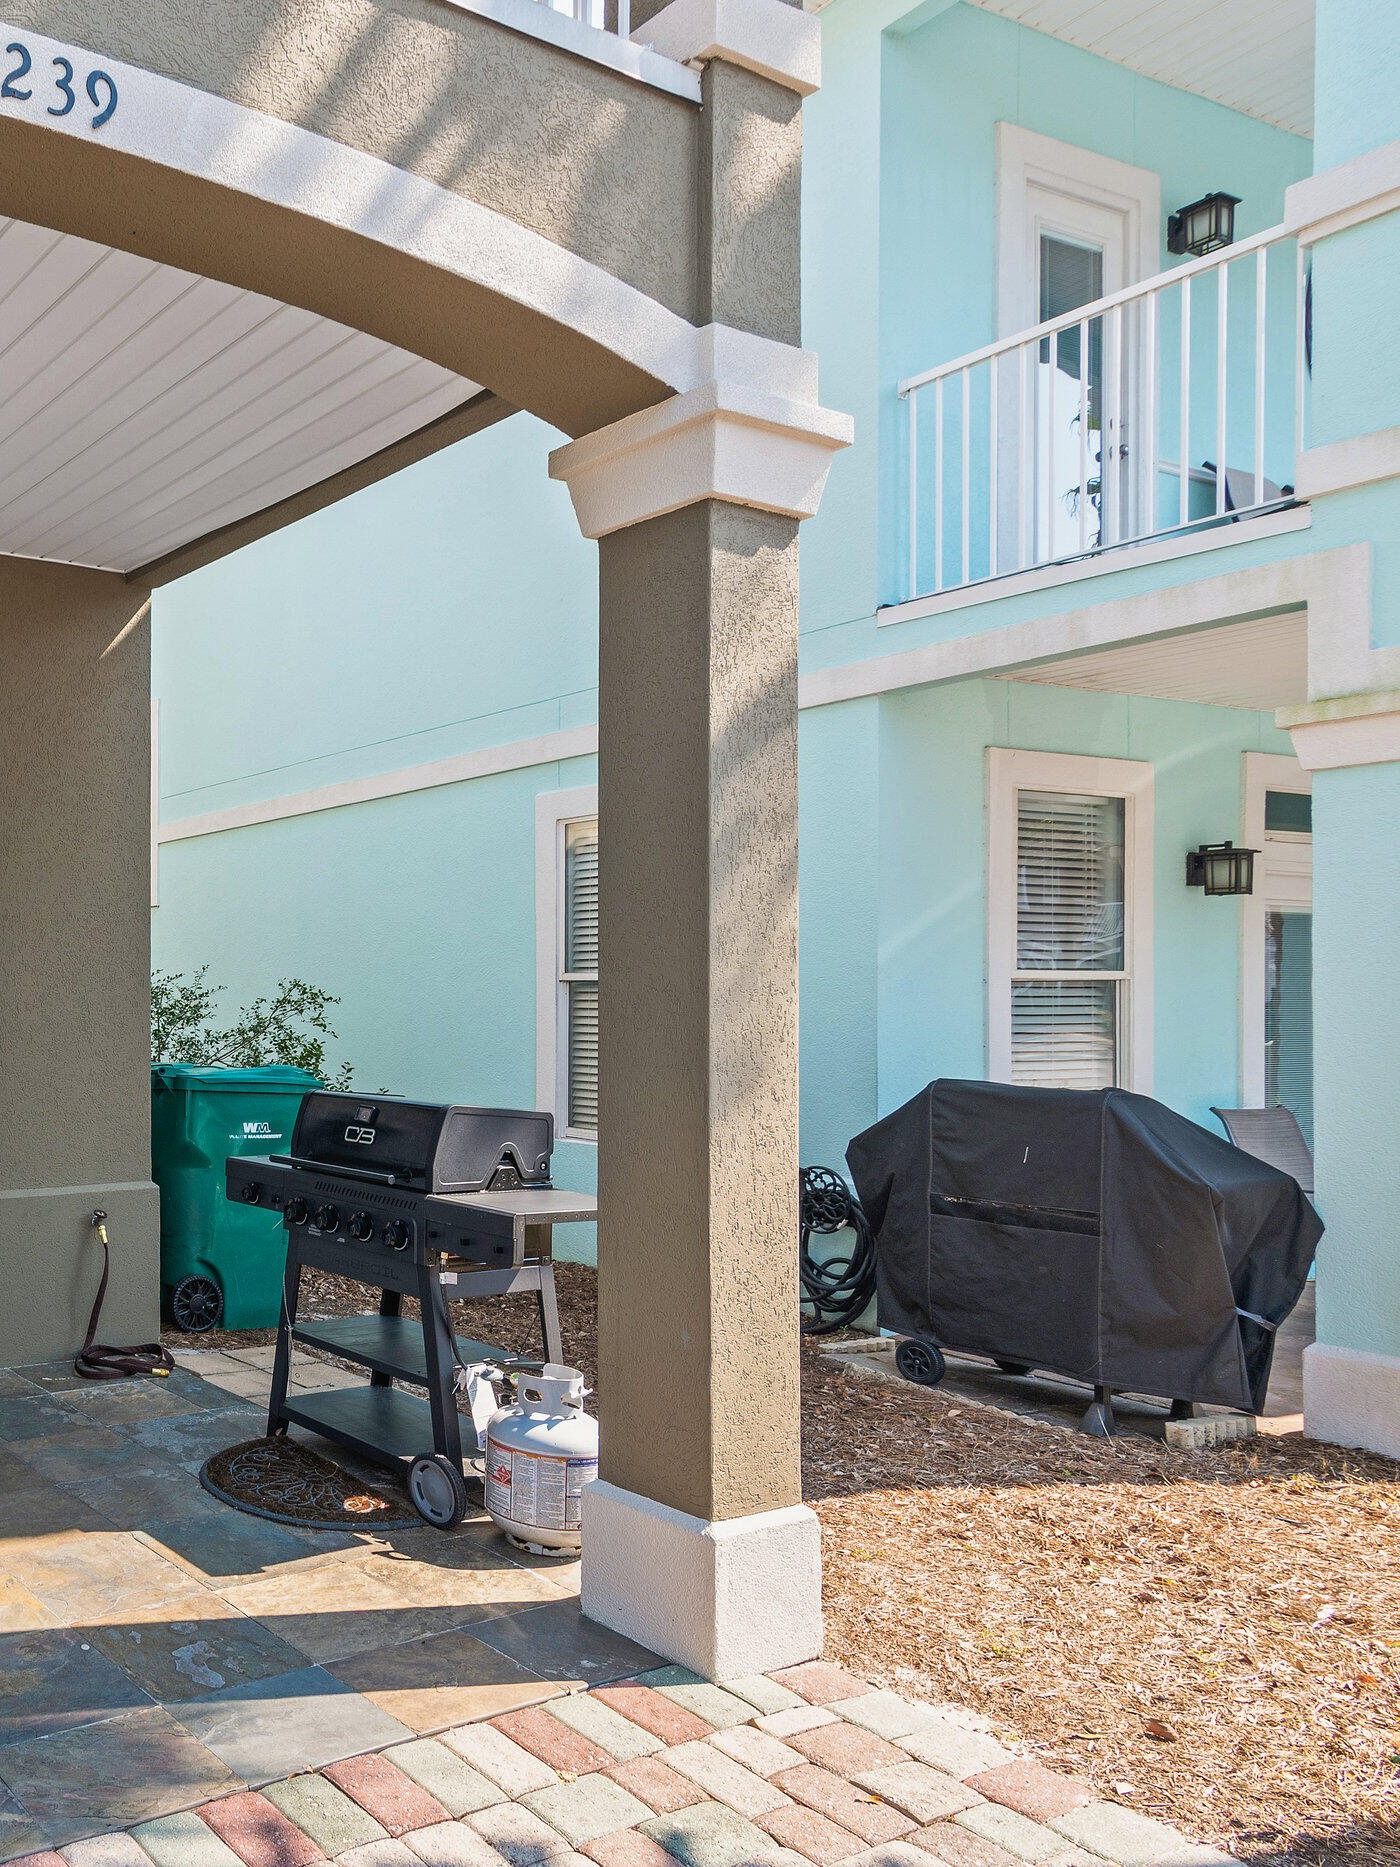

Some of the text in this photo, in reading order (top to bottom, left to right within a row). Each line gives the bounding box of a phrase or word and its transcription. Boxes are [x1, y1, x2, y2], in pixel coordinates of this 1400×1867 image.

[1, 42, 118, 129] 239
[243, 1122, 271, 1133] WM
[345, 1126, 376, 1145] CB
